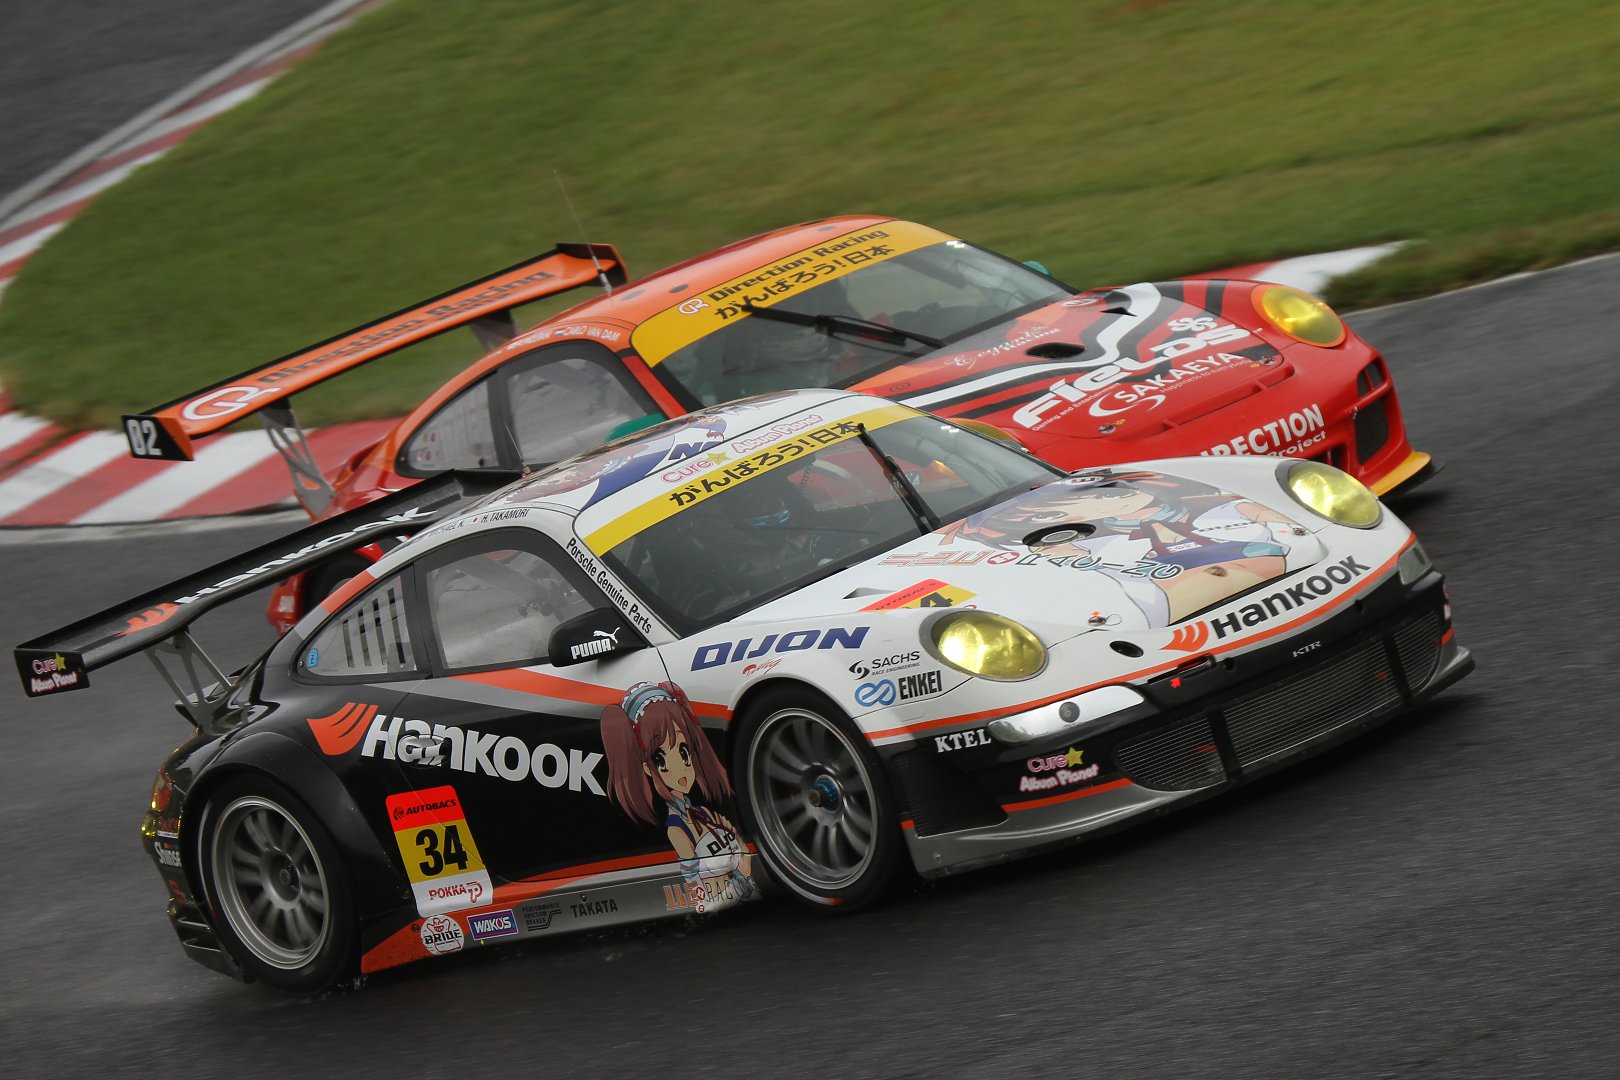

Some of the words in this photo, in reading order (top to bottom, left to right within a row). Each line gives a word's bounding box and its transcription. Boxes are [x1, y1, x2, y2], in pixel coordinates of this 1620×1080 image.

[707, 256, 814, 302] Direction
[817, 229, 890, 257] Racing
[1114, 351, 1244, 403] SAKAEYA
[1031, 414, 1060, 431] Gaming
[1060, 405, 1075, 418] and
[660, 459, 714, 484] Cure
[731, 427, 782, 453] Album
[780, 414, 823, 436] Planet
[565, 537, 597, 577] Porsche
[596, 570, 629, 611] Genuine
[629, 603, 652, 634] Parts
[570, 638, 613, 660] PUMA
[691, 626, 871, 672] DIJON
[872, 651, 920, 669] SACHS
[32, 659, 57, 674] Cure
[899, 670, 942, 700] ENKEI
[934, 728, 992, 753] KTEL
[1027, 755, 1068, 773] Cure
[1020, 776, 1059, 792] Album
[1056, 764, 1099, 785] Planet
[405, 799, 457, 816] AUTOBACS
[415, 824, 468, 877] 34
[428, 883, 467, 901] POKKA
[570, 899, 618, 918] TAKATA
[423, 929, 462, 946] BRIDE
